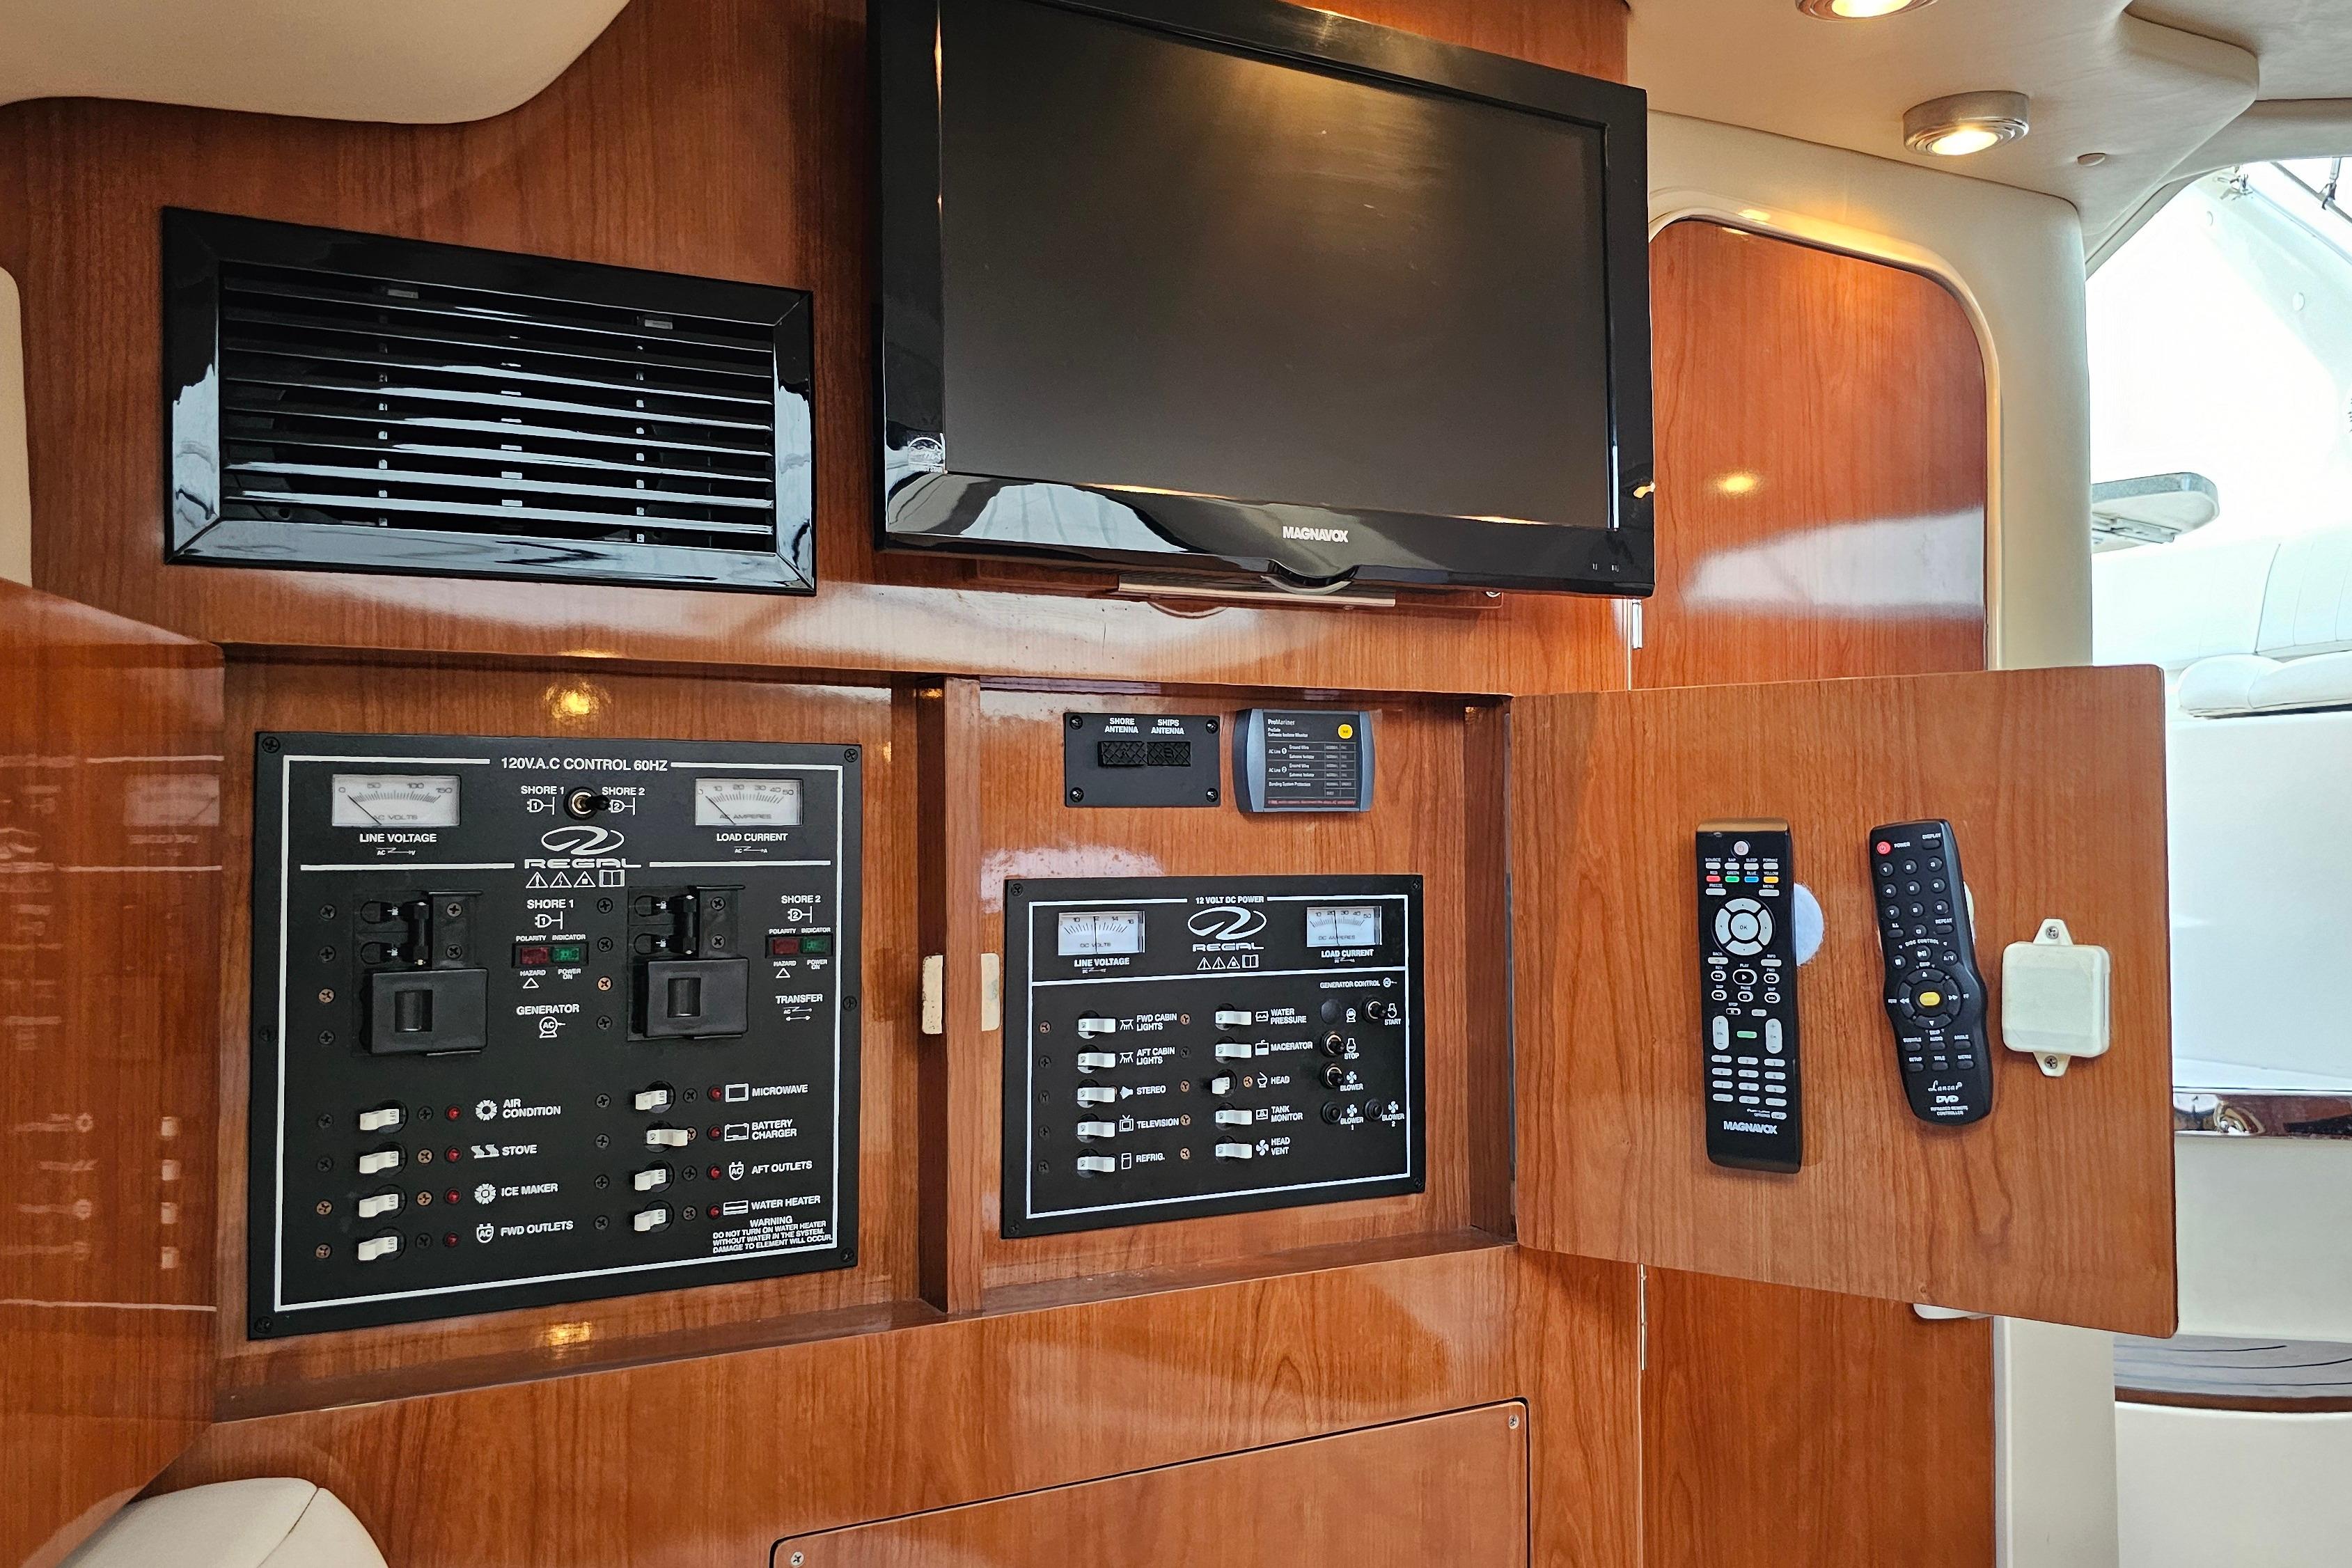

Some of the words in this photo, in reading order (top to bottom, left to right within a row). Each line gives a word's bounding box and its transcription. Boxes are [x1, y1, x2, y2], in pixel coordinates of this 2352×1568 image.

[1283, 526, 1349, 543] MAGNAVOX
[1104, 726, 1139, 734] ANTENNA
[564, 758, 632, 770] CONTROL
[634, 760, 668, 771] 60HZ
[521, 785, 557, 795] SHORE
[602, 787, 637, 796] SHORE
[638, 787, 645, 796] 2
[359, 833, 385, 842] LINE
[387, 833, 437, 843] VOLTAGE
[716, 833, 742, 841] LOAD
[744, 833, 788, 842] CURRENT
[524, 858, 642, 869] REGAL
[526, 899, 567, 909] SHORE
[569, 900, 574, 909] 1
[781, 895, 814, 904] SHORE
[815, 895, 822, 903] 2
[1237, 895, 1264, 904] POWER
[1192, 942, 1264, 952] REGAL
[1341, 949, 1374, 957] CURRENT
[1074, 959, 1093, 967] LINE
[1094, 957, 1130, 966] VOLTAGE
[775, 994, 824, 1004] TRANSFER
[517, 1003, 580, 1015] GENERATOR
[1271, 1008, 1295, 1017] WATER
[1136, 1014, 1154, 1023] FWD
[1154, 1013, 1177, 1022] CABIN
[1271, 1015, 1307, 1025] PRESSURE
[1136, 1023, 1163, 1032] LIGHTS
[1136, 1048, 1152, 1056] AFT
[1152, 1046, 1175, 1056] CABIN
[1271, 1041, 1313, 1051] MACERATOR
[1136, 1056, 1163, 1065] LIGHTS
[1271, 1076, 1290, 1085] HEAD
[752, 1084, 808, 1097] MICROWAVE
[1136, 1085, 1166, 1095] STEREO
[1340, 1083, 1364, 1092] BLOWER
[503, 1099, 522, 1108] AIR
[1936, 1095, 1959, 1104] DVD
[503, 1106, 561, 1119] CONDITION
[1271, 1105, 1290, 1114] TANK
[1271, 1113, 1303, 1122] MONITOR
[1340, 1117, 1364, 1125] BLOWER
[1381, 1113, 1405, 1122] BLOWER
[752, 1119, 793, 1131] BATTERY
[1136, 1118, 1179, 1129] TELEVISION
[1723, 1120, 1778, 1134] MAGNAVOX
[752, 1129, 797, 1140] CHARGER
[1271, 1136, 1291, 1146] HEAD
[501, 1144, 538, 1157] STOVE
[1271, 1147, 1289, 1156] VENT
[1136, 1152, 1166, 1163] REFRIG.
[752, 1164, 769, 1175] AFT
[771, 1161, 813, 1173] OUTLETS
[501, 1186, 519, 1198] ICE
[521, 1182, 558, 1195] MAKER
[751, 1199, 783, 1210] WATER
[785, 1195, 821, 1207] HEATER
[750, 1216, 793, 1228] WARNING
[479, 1229, 492, 1238] AC
[501, 1225, 525, 1237] FWD
[526, 1220, 574, 1234] OUTLETS
[713, 1231, 724, 1239] DO
[726, 1230, 742, 1239] NOT
[742, 1228, 761, 1237] TURN
[774, 1224, 799, 1234] WATER
[800, 1221, 826, 1230] HEATER
[713, 1237, 746, 1246] WITHOUT
[747, 1234, 771, 1244] WATER
[781, 1230, 794, 1239] THE
[796, 1228, 825, 1237] SYSTEM.
[713, 1244, 744, 1254] DAMAGE
[755, 1239, 788, 1248] ELEMENT
[789, 1236, 806, 1245] WILL
